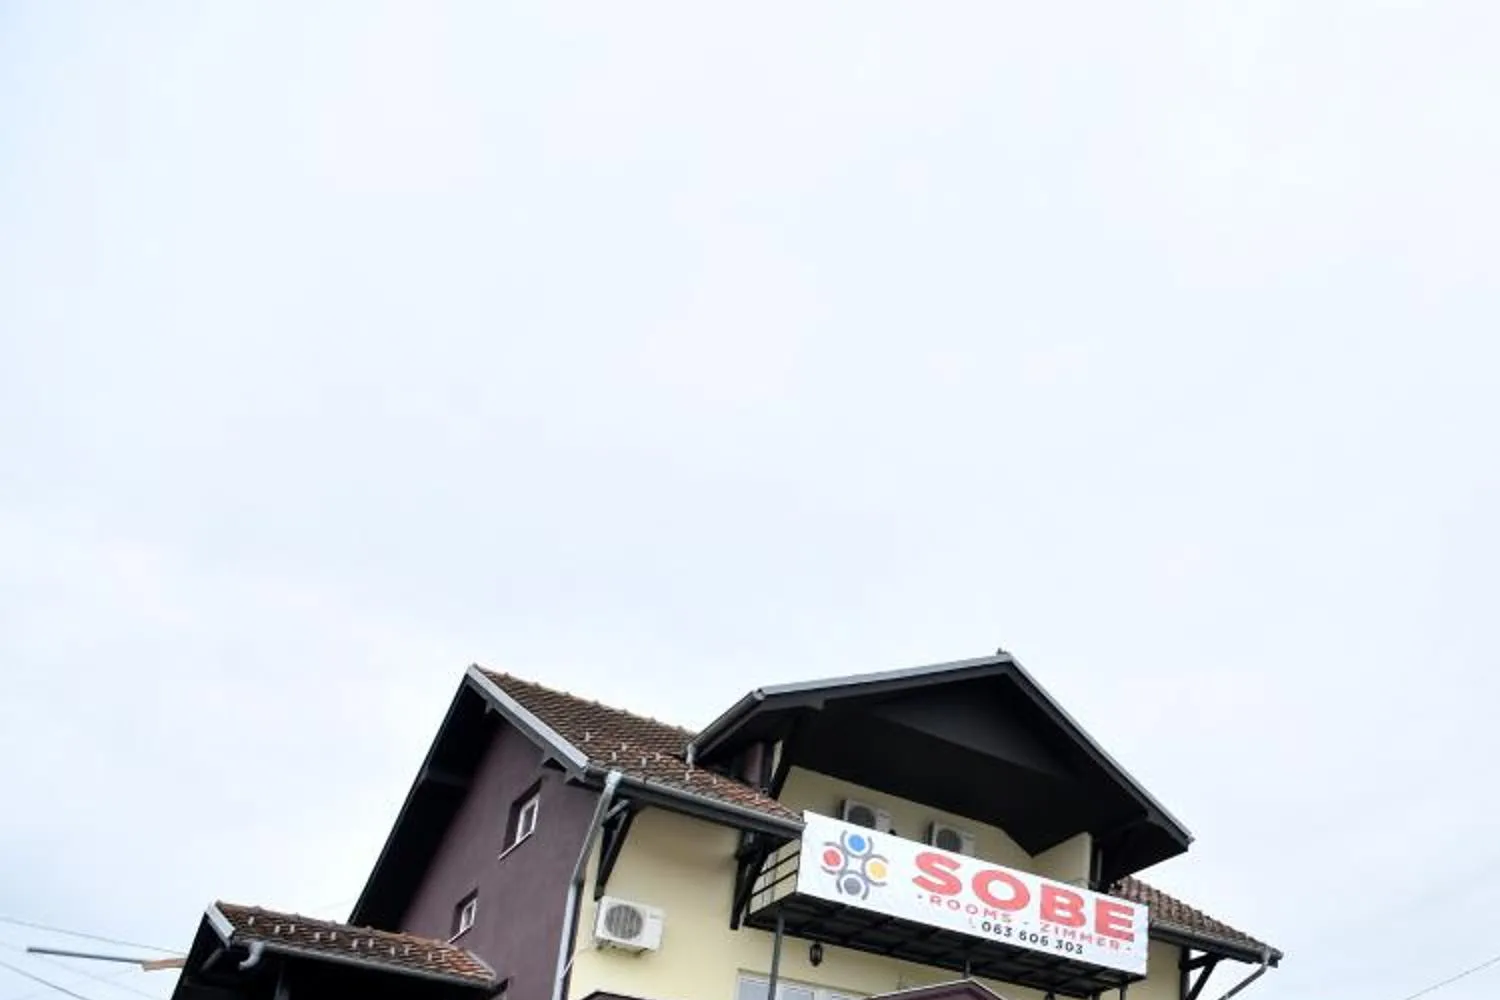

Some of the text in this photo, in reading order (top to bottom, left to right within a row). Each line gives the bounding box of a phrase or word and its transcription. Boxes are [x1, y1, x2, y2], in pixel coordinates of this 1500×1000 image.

[911, 851, 1135, 943] SOBE
[929, 895, 1121, 951] ROOMS ZIMMER
[981, 921, 1013, 937] 063
[1055, 938, 1084, 955] 303
